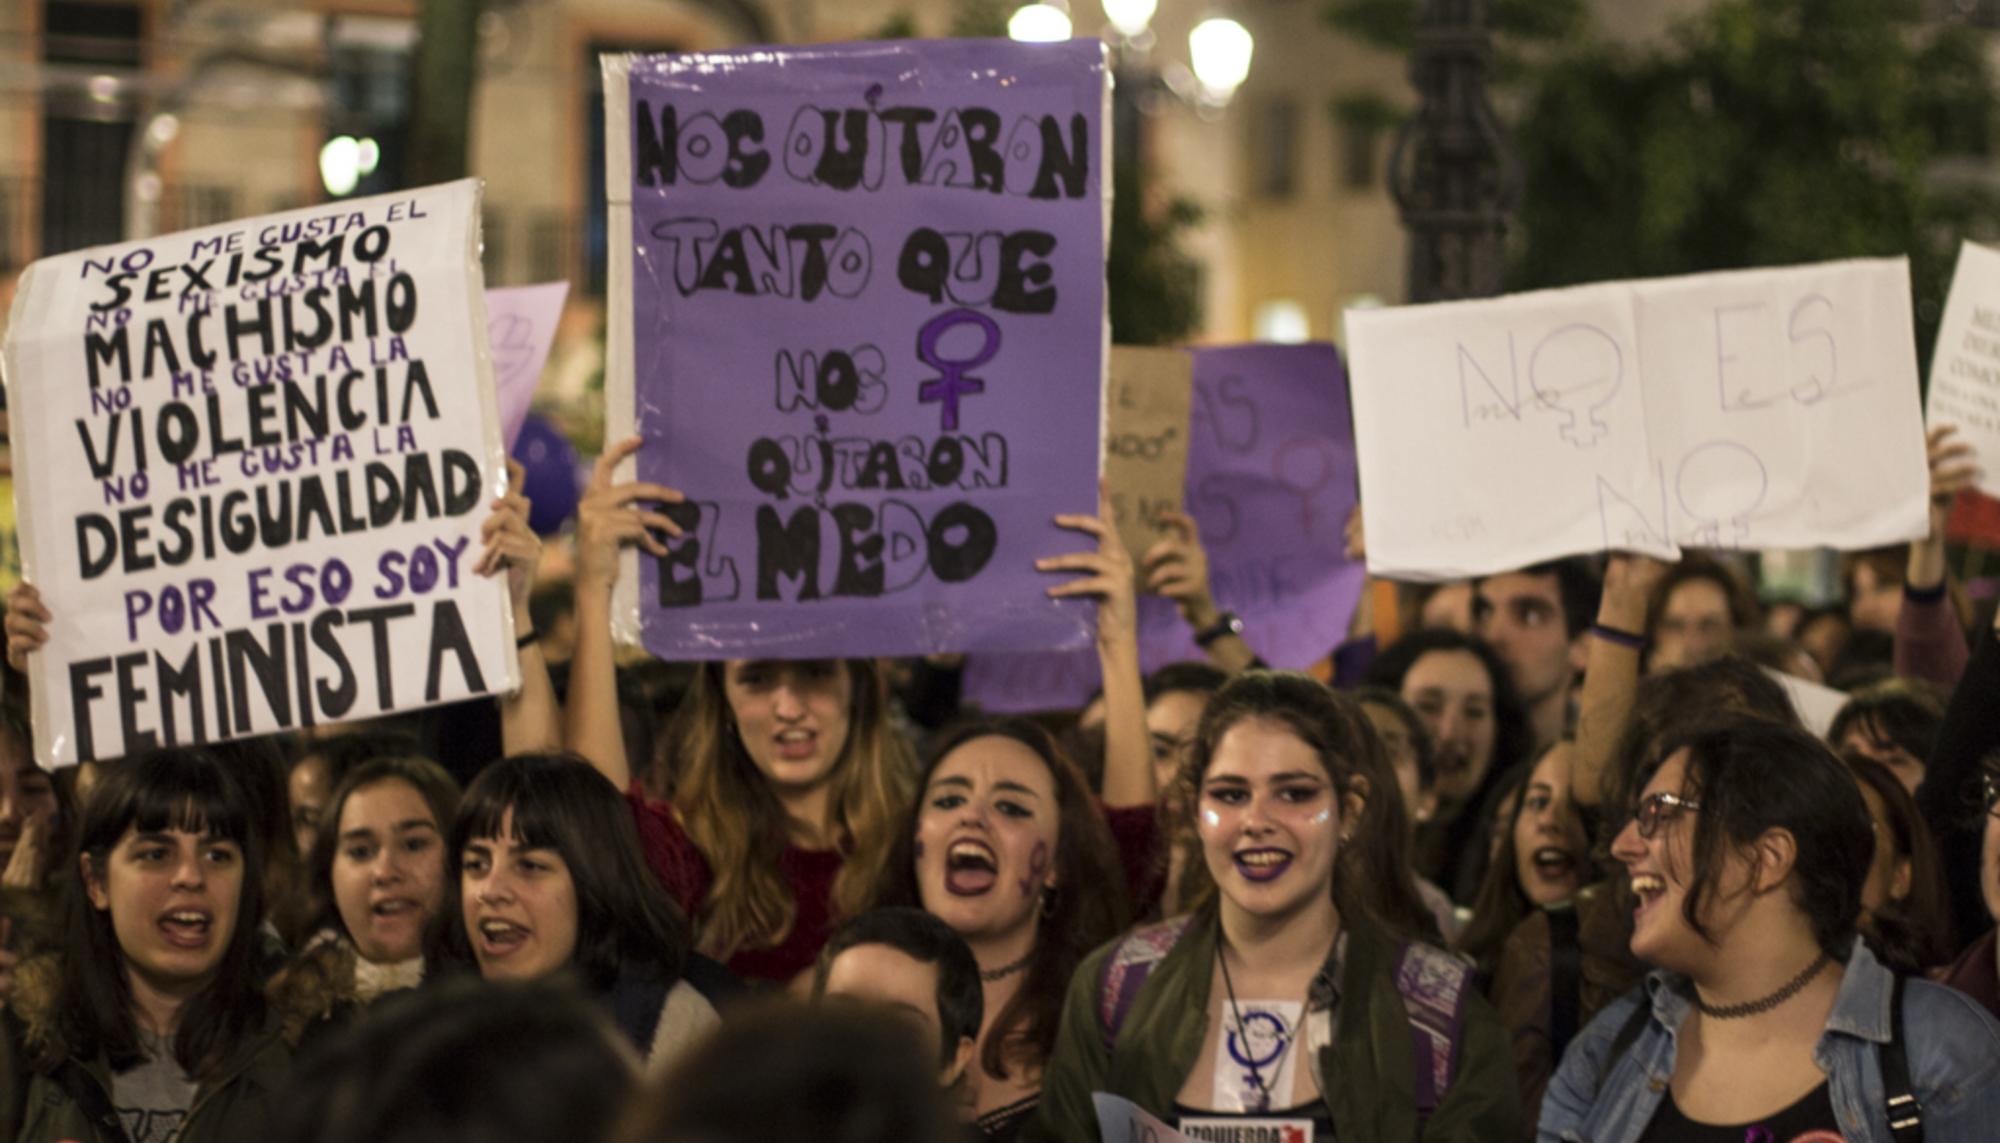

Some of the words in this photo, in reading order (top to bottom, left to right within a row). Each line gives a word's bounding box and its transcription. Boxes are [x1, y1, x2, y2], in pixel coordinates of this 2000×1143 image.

[636, 98, 771, 188] NOS
[783, 83, 1089, 199] QUITARON
[81, 248, 154, 279] NO
[190, 231, 245, 260] ME
[259, 212, 366, 247] GUSTA
[386, 200, 427, 223] EL
[89, 225, 391, 312] SEXISMO
[651, 216, 873, 302] TANTO
[897, 227, 1058, 314] QUE
[85, 271, 417, 388] MACHISMO
[86, 308, 132, 333] NO
[241, 266, 350, 301] GUSTA
[75, 359, 440, 480] VIOLENCIA
[91, 387, 132, 415] NO
[172, 371, 214, 399] ME
[232, 346, 354, 387] GUSTA
[370, 336, 408, 366] LA
[775, 342, 888, 415] NOS
[1457, 323, 1624, 447] NO
[1714, 292, 1838, 412] ES
[103, 471, 150, 506] NO
[177, 457, 221, 491] ME
[240, 434, 355, 478] GUSTA
[374, 425, 418, 455] LA
[747, 415, 1008, 501] QUITARON
[1596, 439, 1768, 549] NO
[75, 449, 482, 580] DESIGUALDAD
[653, 499, 740, 607] EL
[756, 499, 998, 602] MIEDO
[124, 579, 222, 643] POR
[247, 558, 353, 620] ESO
[374, 534, 470, 600] SOY
[68, 599, 488, 763] FEMINISTA
